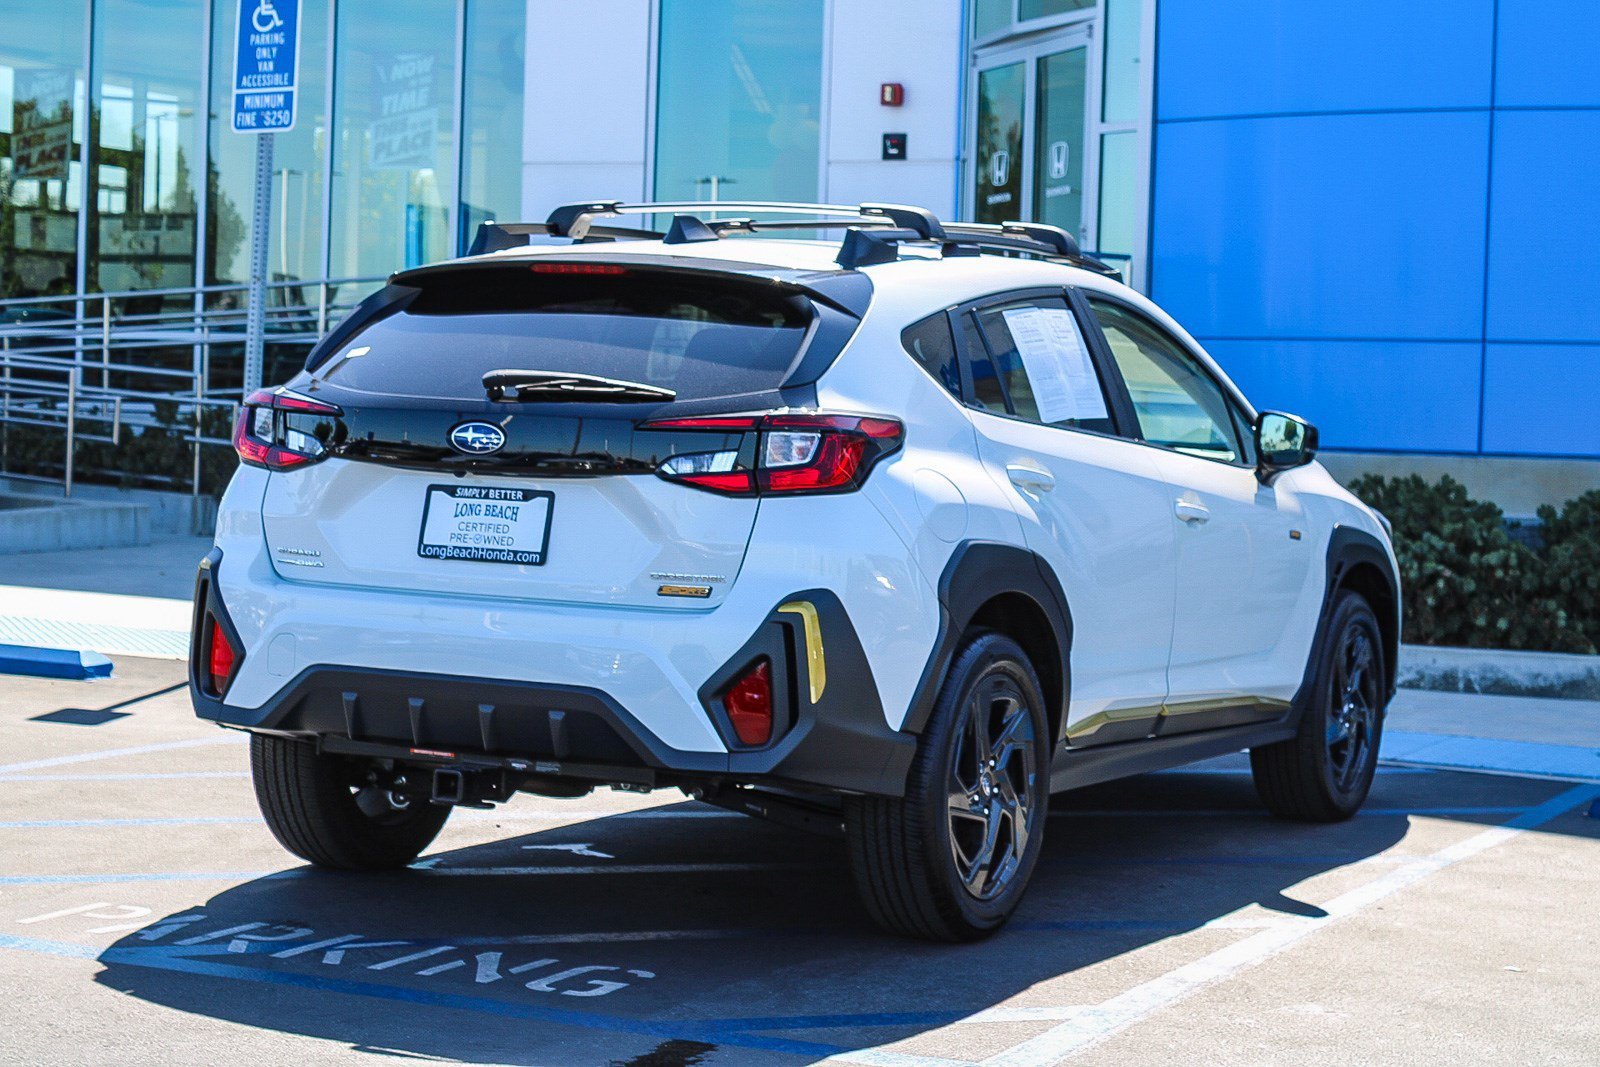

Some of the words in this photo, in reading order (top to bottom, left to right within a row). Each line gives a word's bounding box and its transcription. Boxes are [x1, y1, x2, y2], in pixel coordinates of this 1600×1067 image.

[249, 32, 286, 46] PARKING
[255, 46, 278, 60] ONLY
[257, 61, 274, 73] VAN
[241, 73, 289, 88] ACCESSIBLE
[243, 94, 285, 110] MINIMUM
[236, 111, 257, 128] FINE
[262, 110, 291, 127] $250
[455, 487, 488, 498] SIMPLY
[488, 489, 524, 500] BETTER
[454, 502, 482, 518] LONG
[483, 504, 520, 522] BEACH
[457, 521, 510, 534] CERTIFIED
[420, 543, 540, 563] LongBeachHonda.com
[15, 901, 656, 997] PARKING
